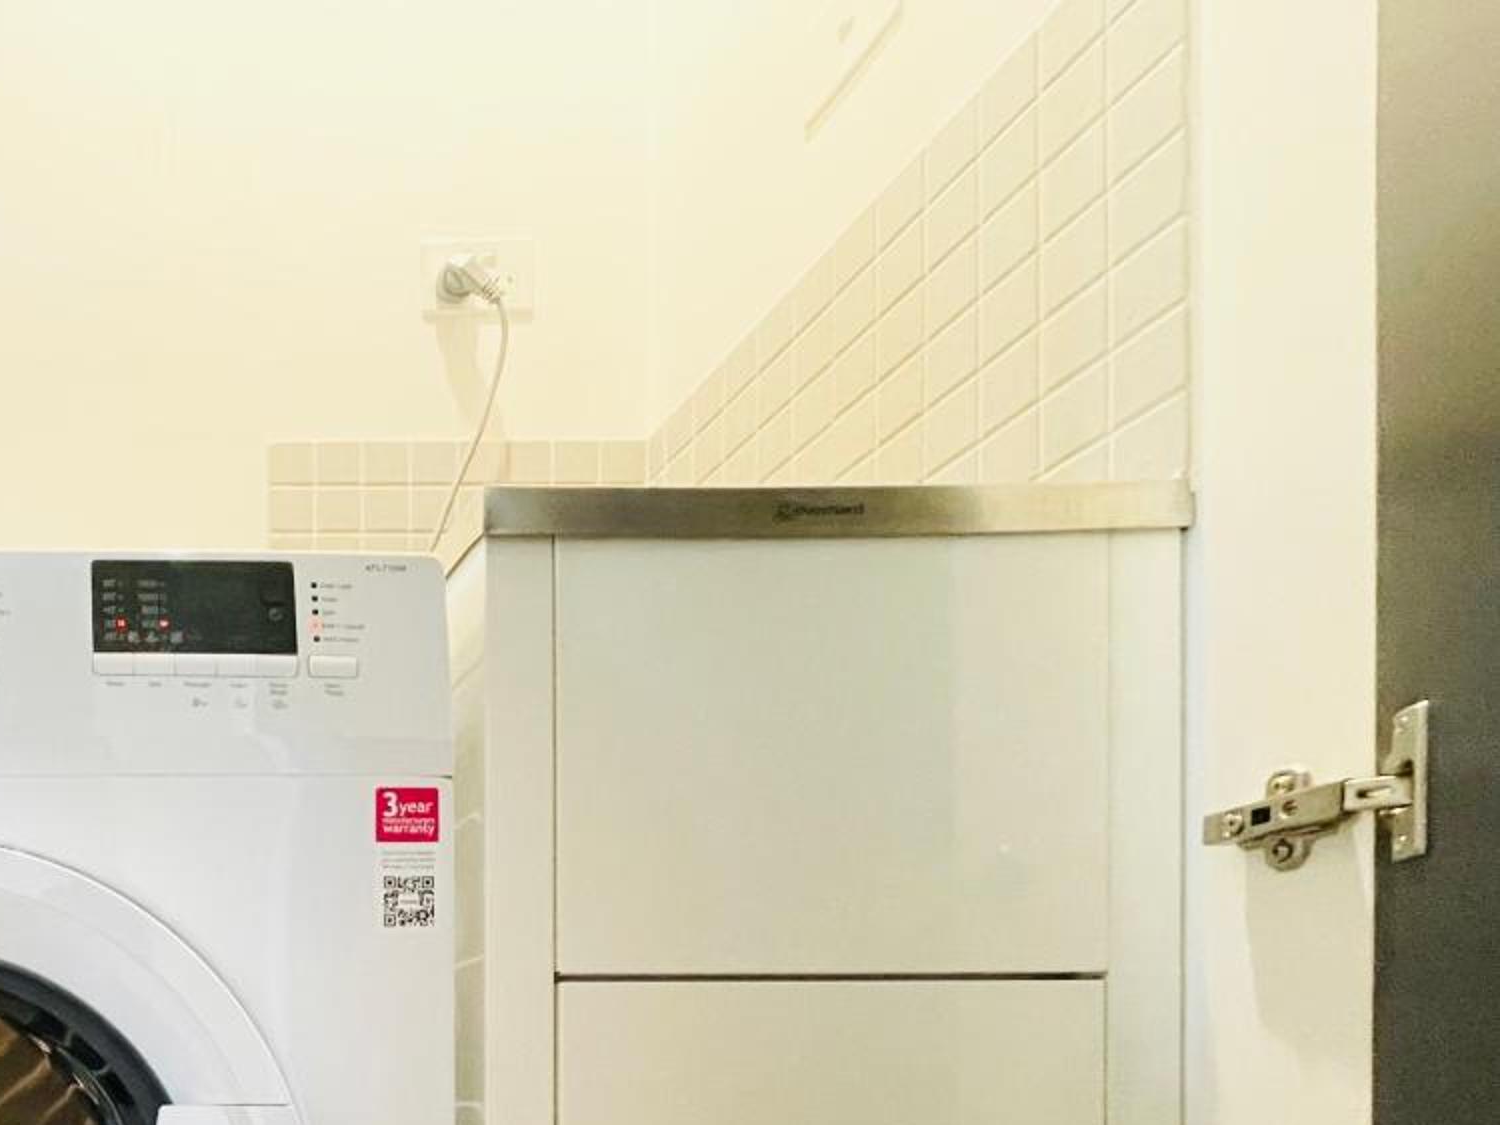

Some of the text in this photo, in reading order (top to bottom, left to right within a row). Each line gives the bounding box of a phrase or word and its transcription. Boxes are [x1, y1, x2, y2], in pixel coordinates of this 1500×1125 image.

[383, 791, 435, 817] 3 year
[382, 824, 435, 837] warranty
